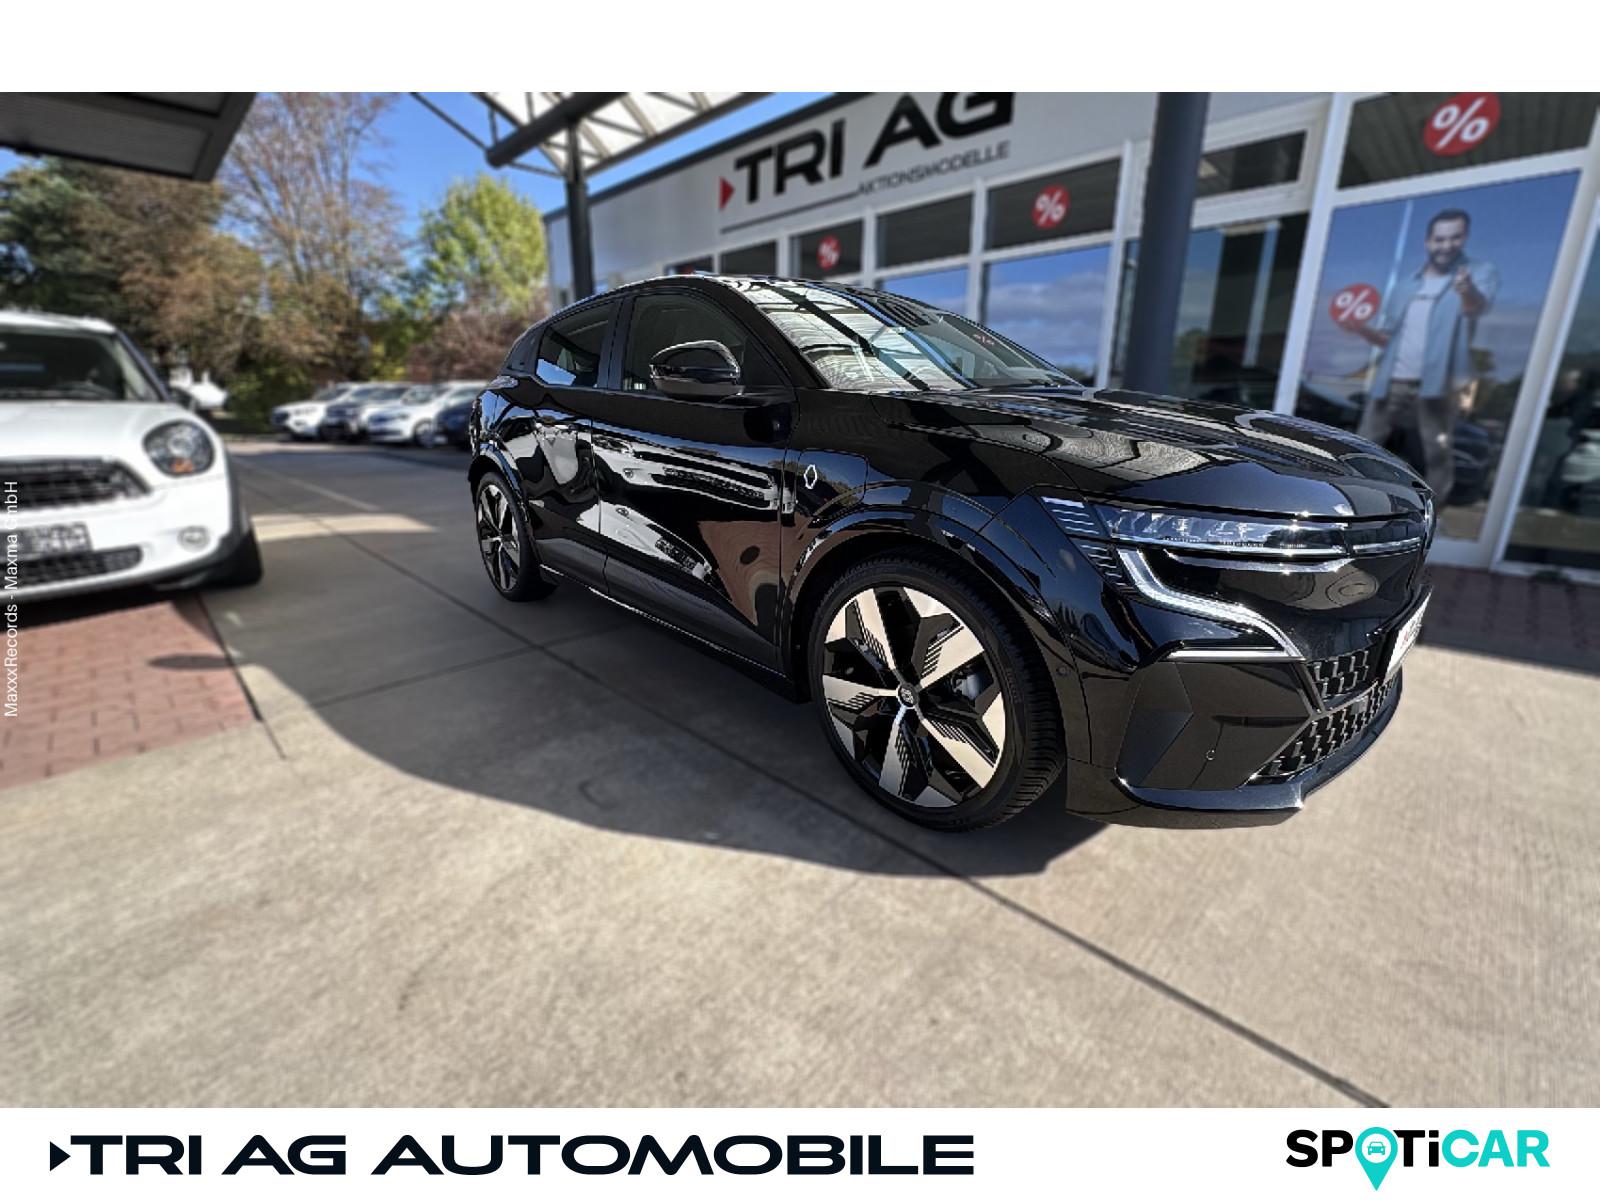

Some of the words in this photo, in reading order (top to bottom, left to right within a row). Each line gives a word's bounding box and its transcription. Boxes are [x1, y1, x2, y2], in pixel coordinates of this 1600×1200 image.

[734, 117, 846, 204] TRI
[862, 91, 1014, 170] AG
[856, 140, 1011, 197] AKTIONSMODELLE
